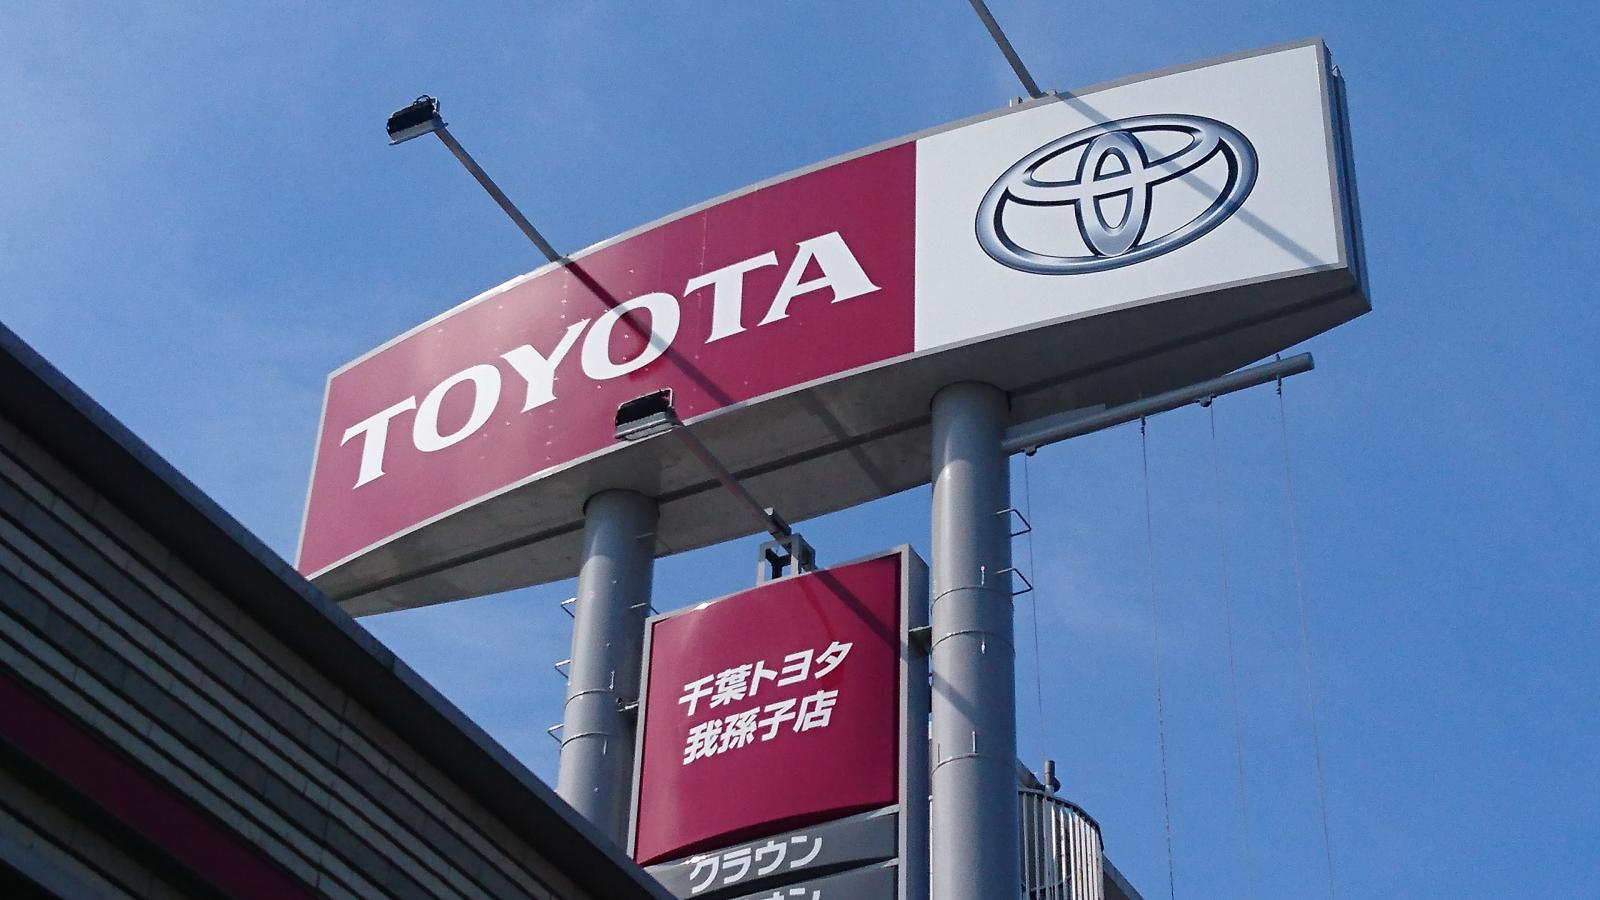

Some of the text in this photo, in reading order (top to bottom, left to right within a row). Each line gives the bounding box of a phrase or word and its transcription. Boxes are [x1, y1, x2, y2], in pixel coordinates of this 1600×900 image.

[340, 231, 881, 489] TOYOTA
[678, 641, 853, 717] 千葉トヨタ
[682, 689, 839, 765] 我孫子店
[689, 835, 823, 894] クラウン
